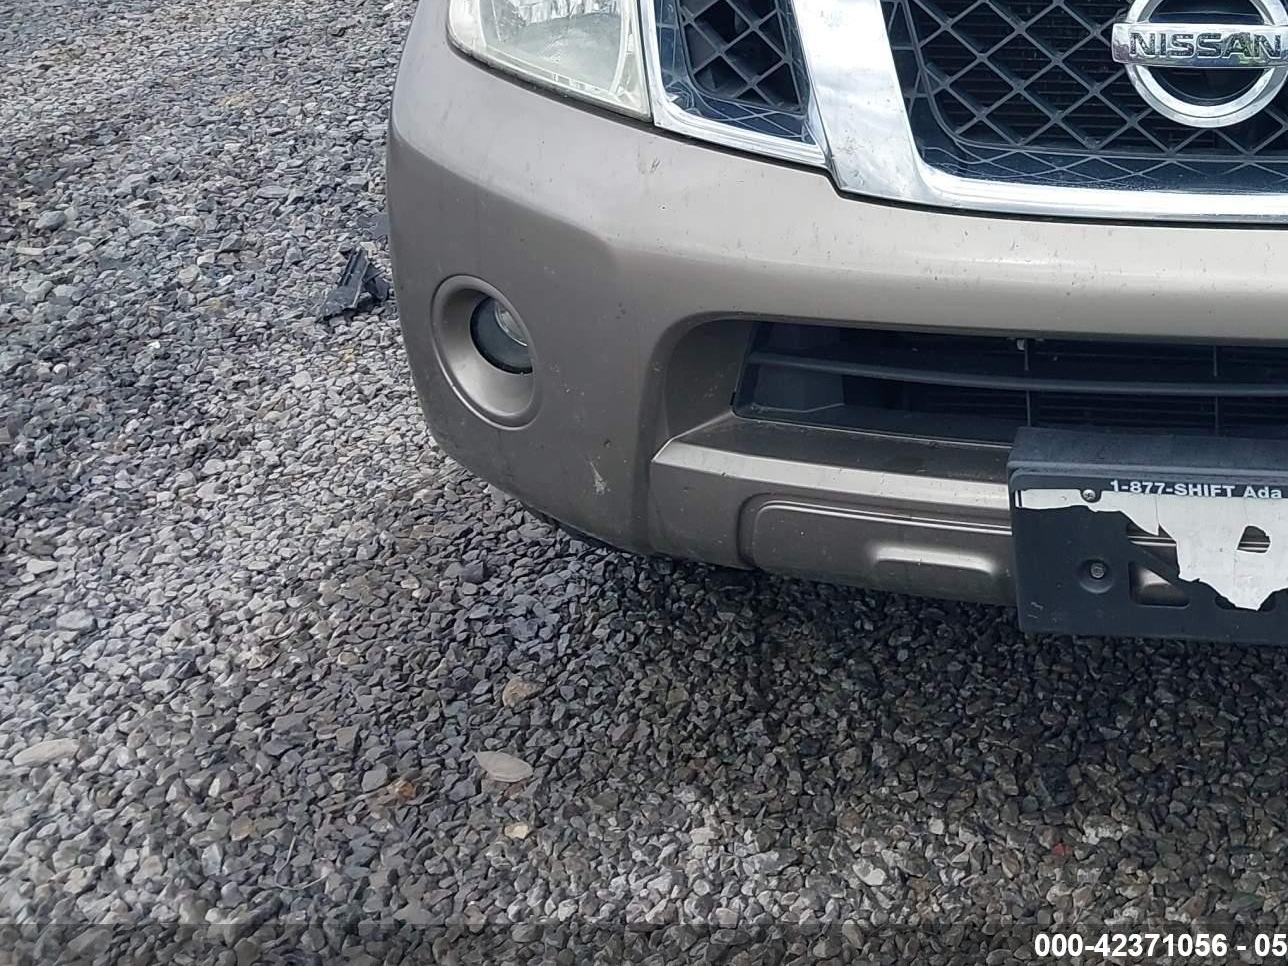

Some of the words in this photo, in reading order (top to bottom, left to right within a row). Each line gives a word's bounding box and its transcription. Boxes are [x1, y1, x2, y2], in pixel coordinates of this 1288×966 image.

[1128, 32, 1283, 60] NISSAN
[1110, 479, 1235, 498] 1-877-SHIFT
[1243, 485, 1283, 500] Ada
